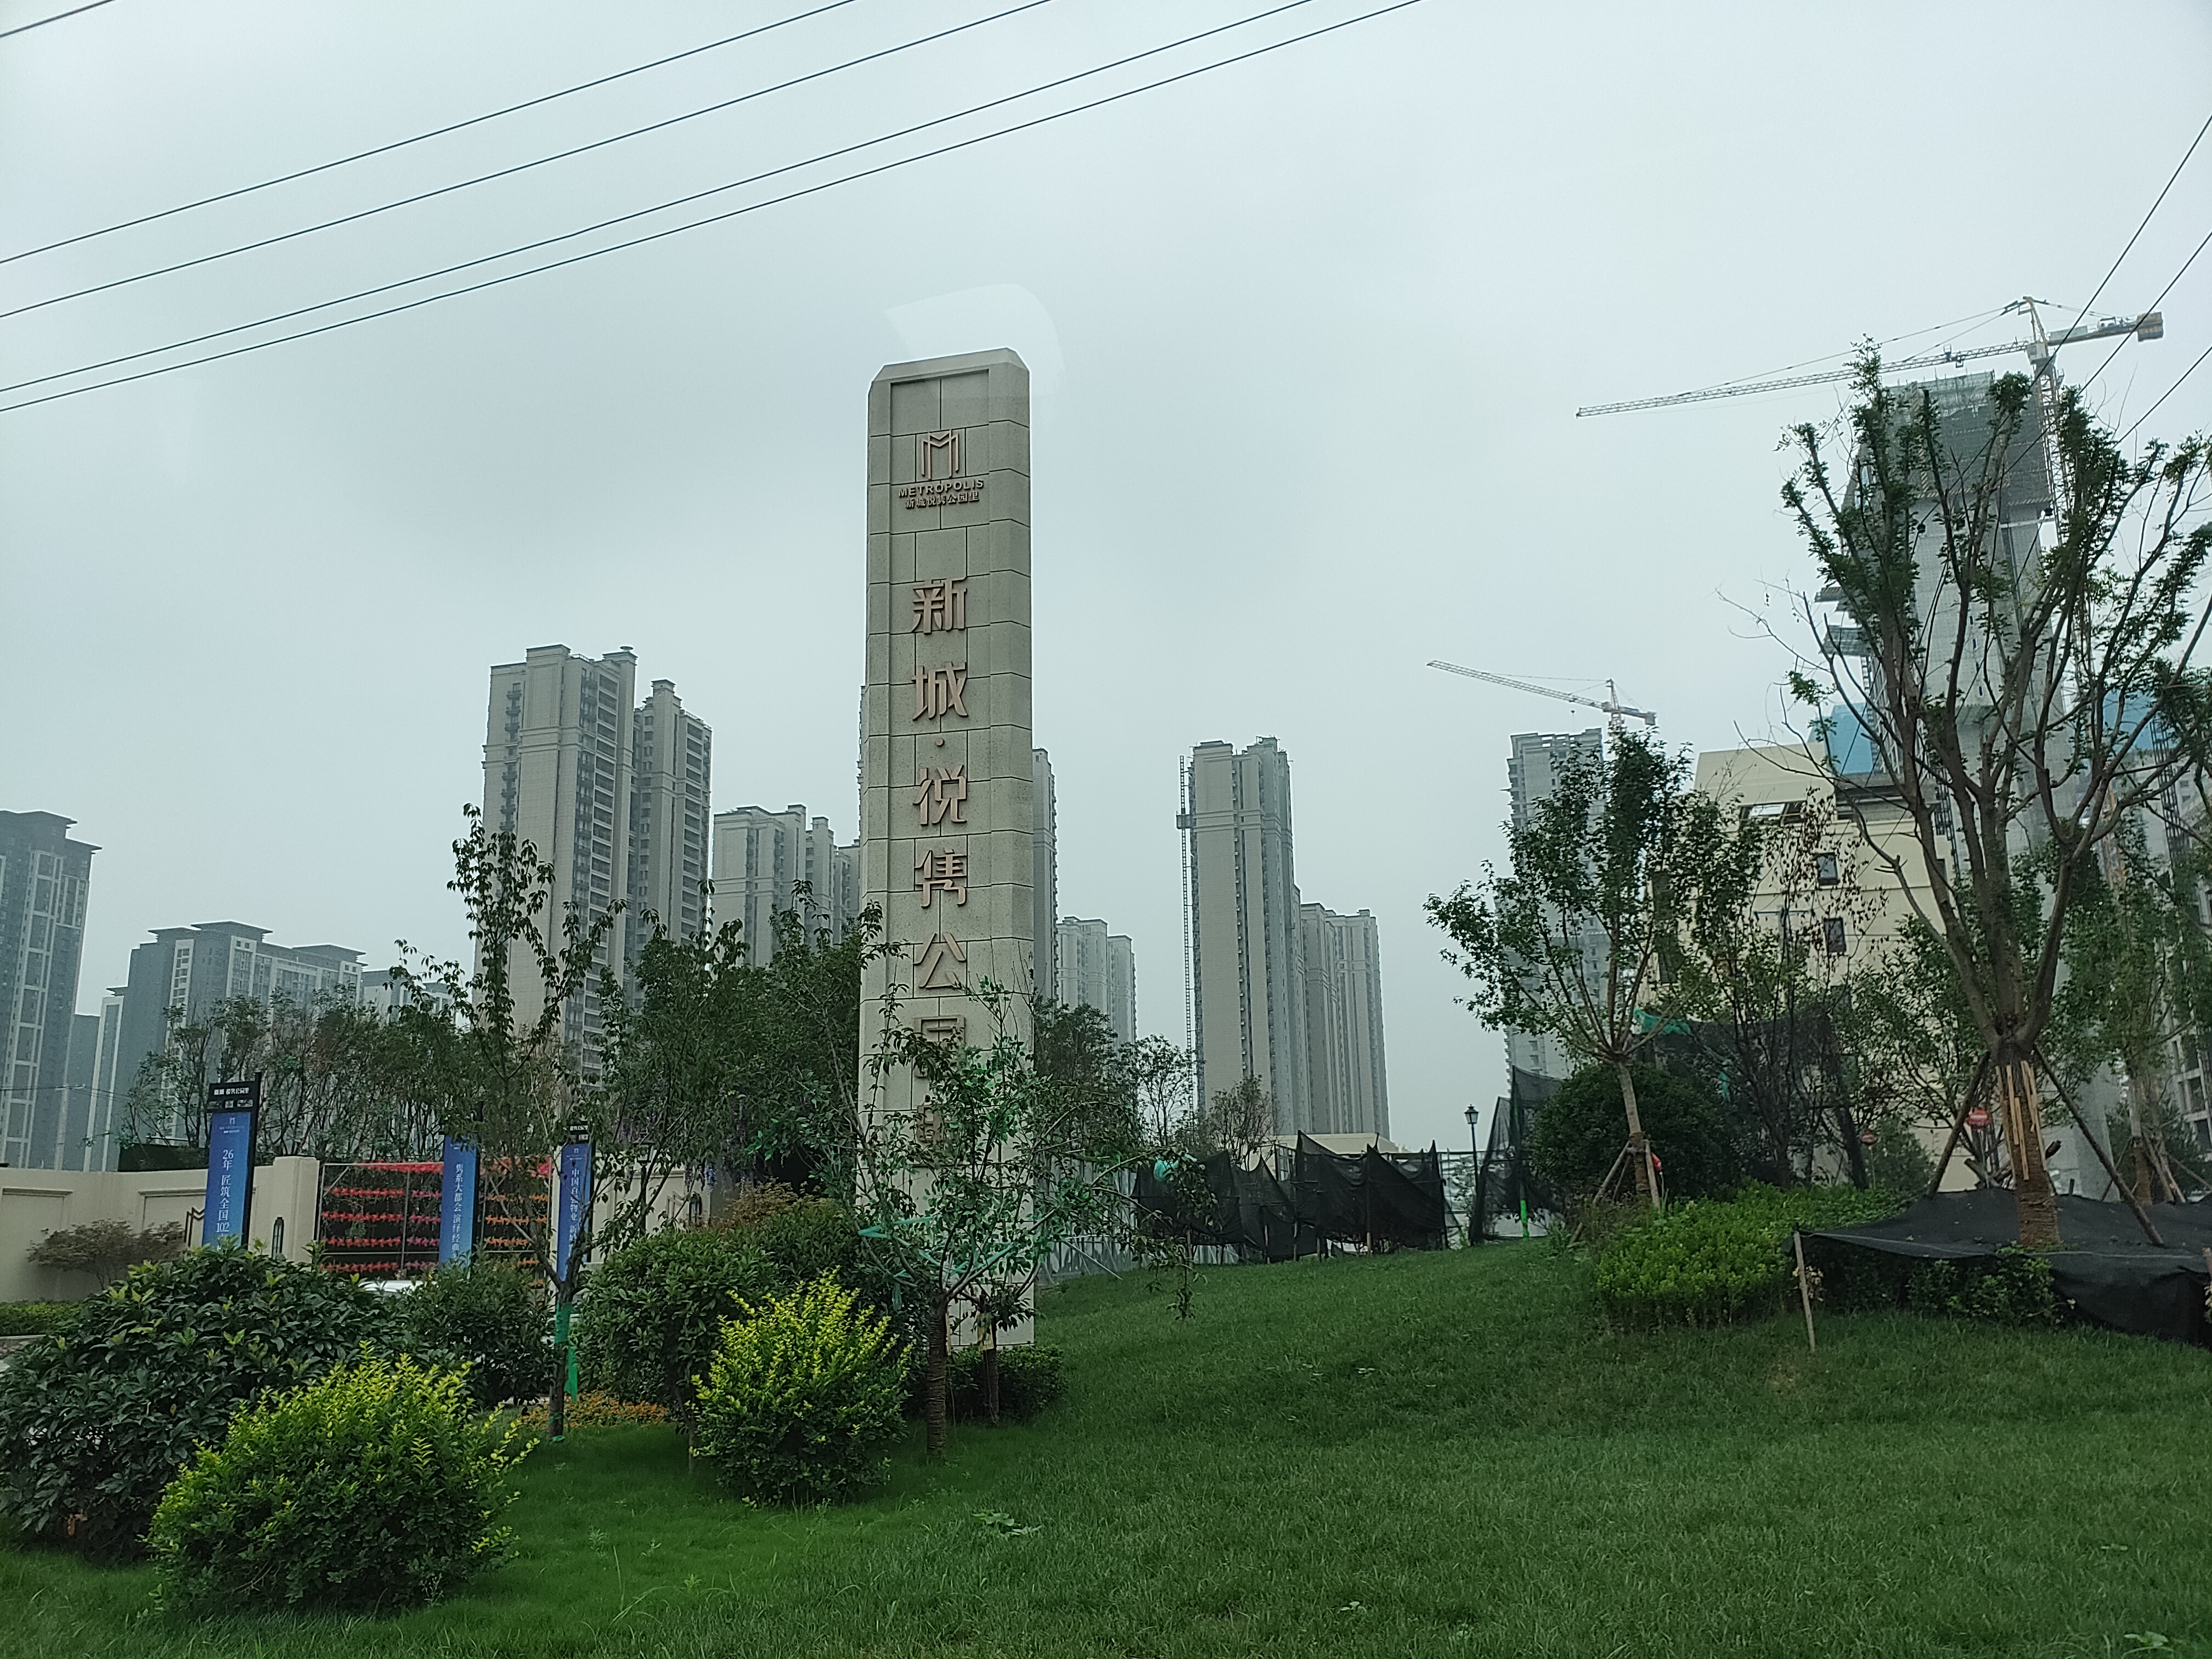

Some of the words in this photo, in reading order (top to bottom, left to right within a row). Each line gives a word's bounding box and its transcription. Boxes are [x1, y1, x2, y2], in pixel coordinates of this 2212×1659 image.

[899, 479, 984, 498] METROPOLIS
[216, 1174, 231, 1251] 匠筑全国102
